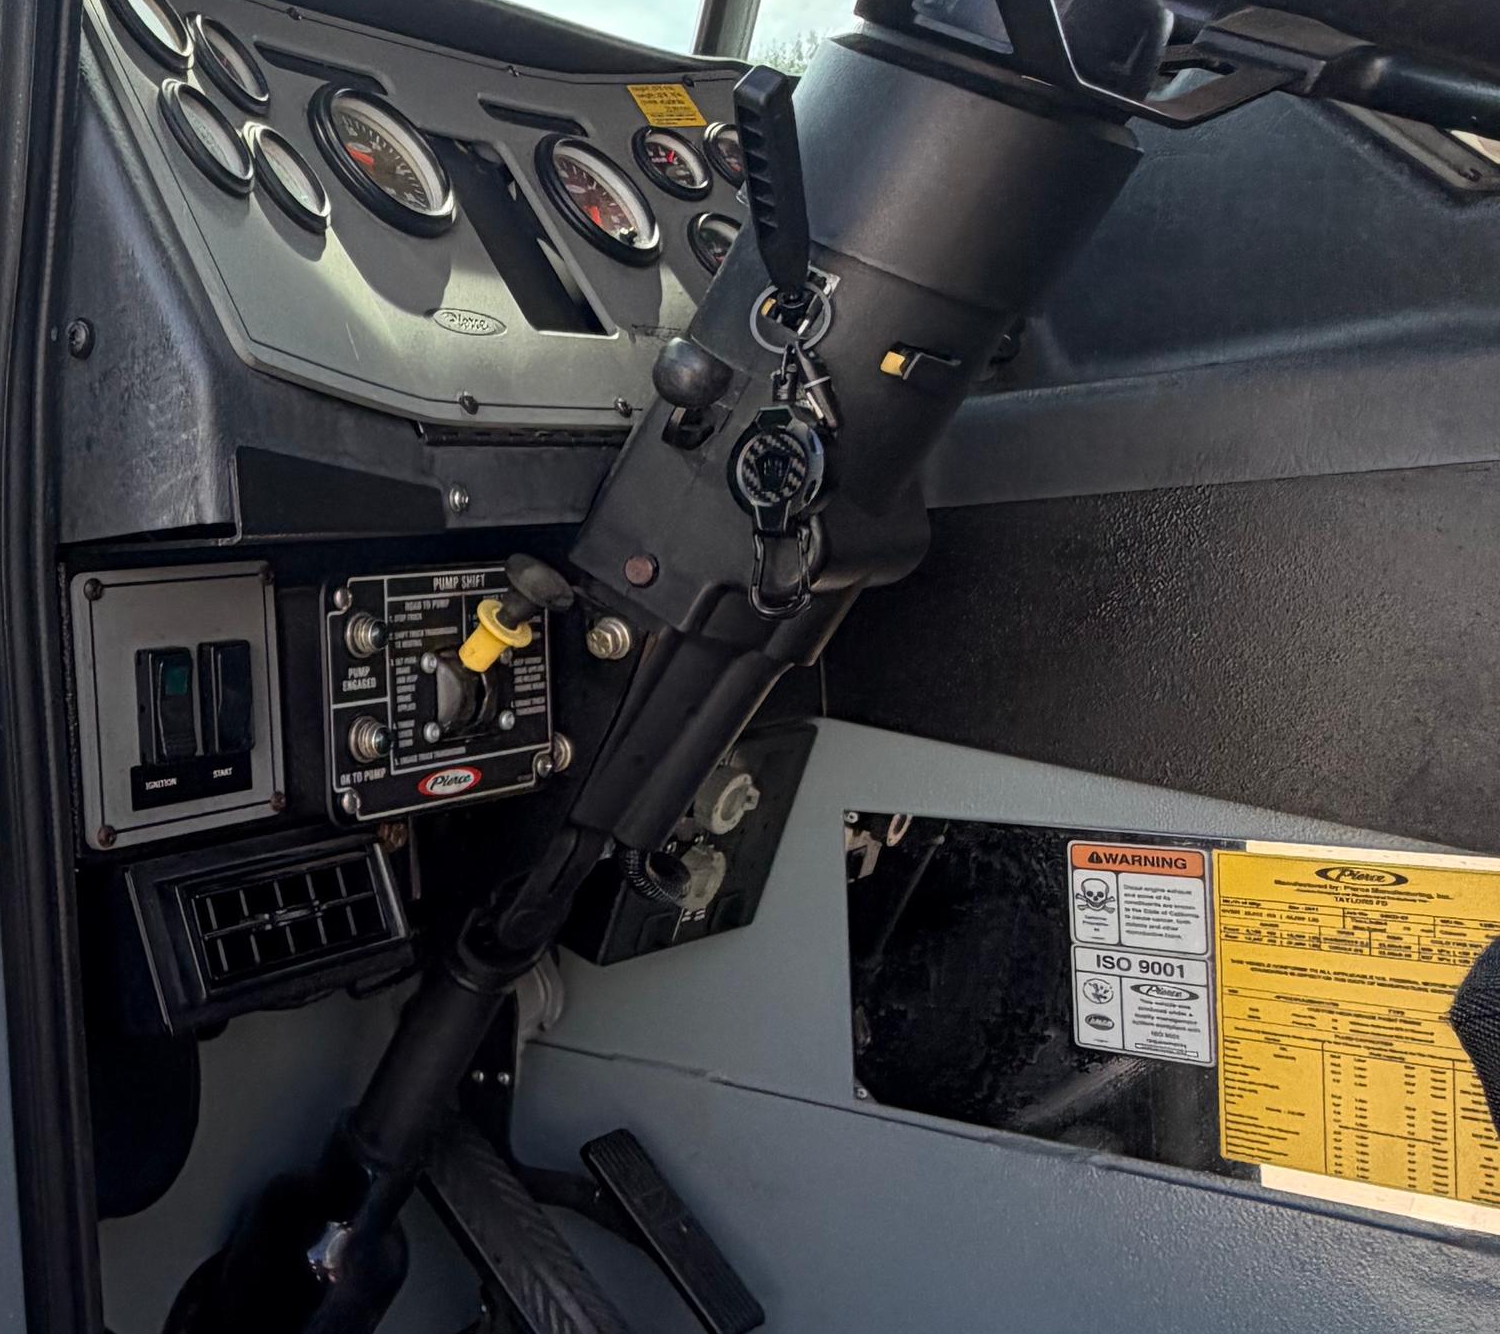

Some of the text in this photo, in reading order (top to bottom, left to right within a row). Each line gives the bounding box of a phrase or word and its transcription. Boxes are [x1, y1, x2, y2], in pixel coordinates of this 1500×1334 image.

[433, 573, 486, 591] PUMP SHIFT
[348, 666, 370, 679] PUMP
[342, 677, 377, 692] ENGAGED
[213, 767, 233, 779] START
[340, 768, 387, 786] OK TO PUMP
[430, 772, 472, 790] Pierce
[145, 778, 178, 791] IGNITION
[1103, 852, 1188, 870] WARNING
[1335, 866, 1386, 884] Pierce
[1096, 954, 1185, 979] ISO 9001
